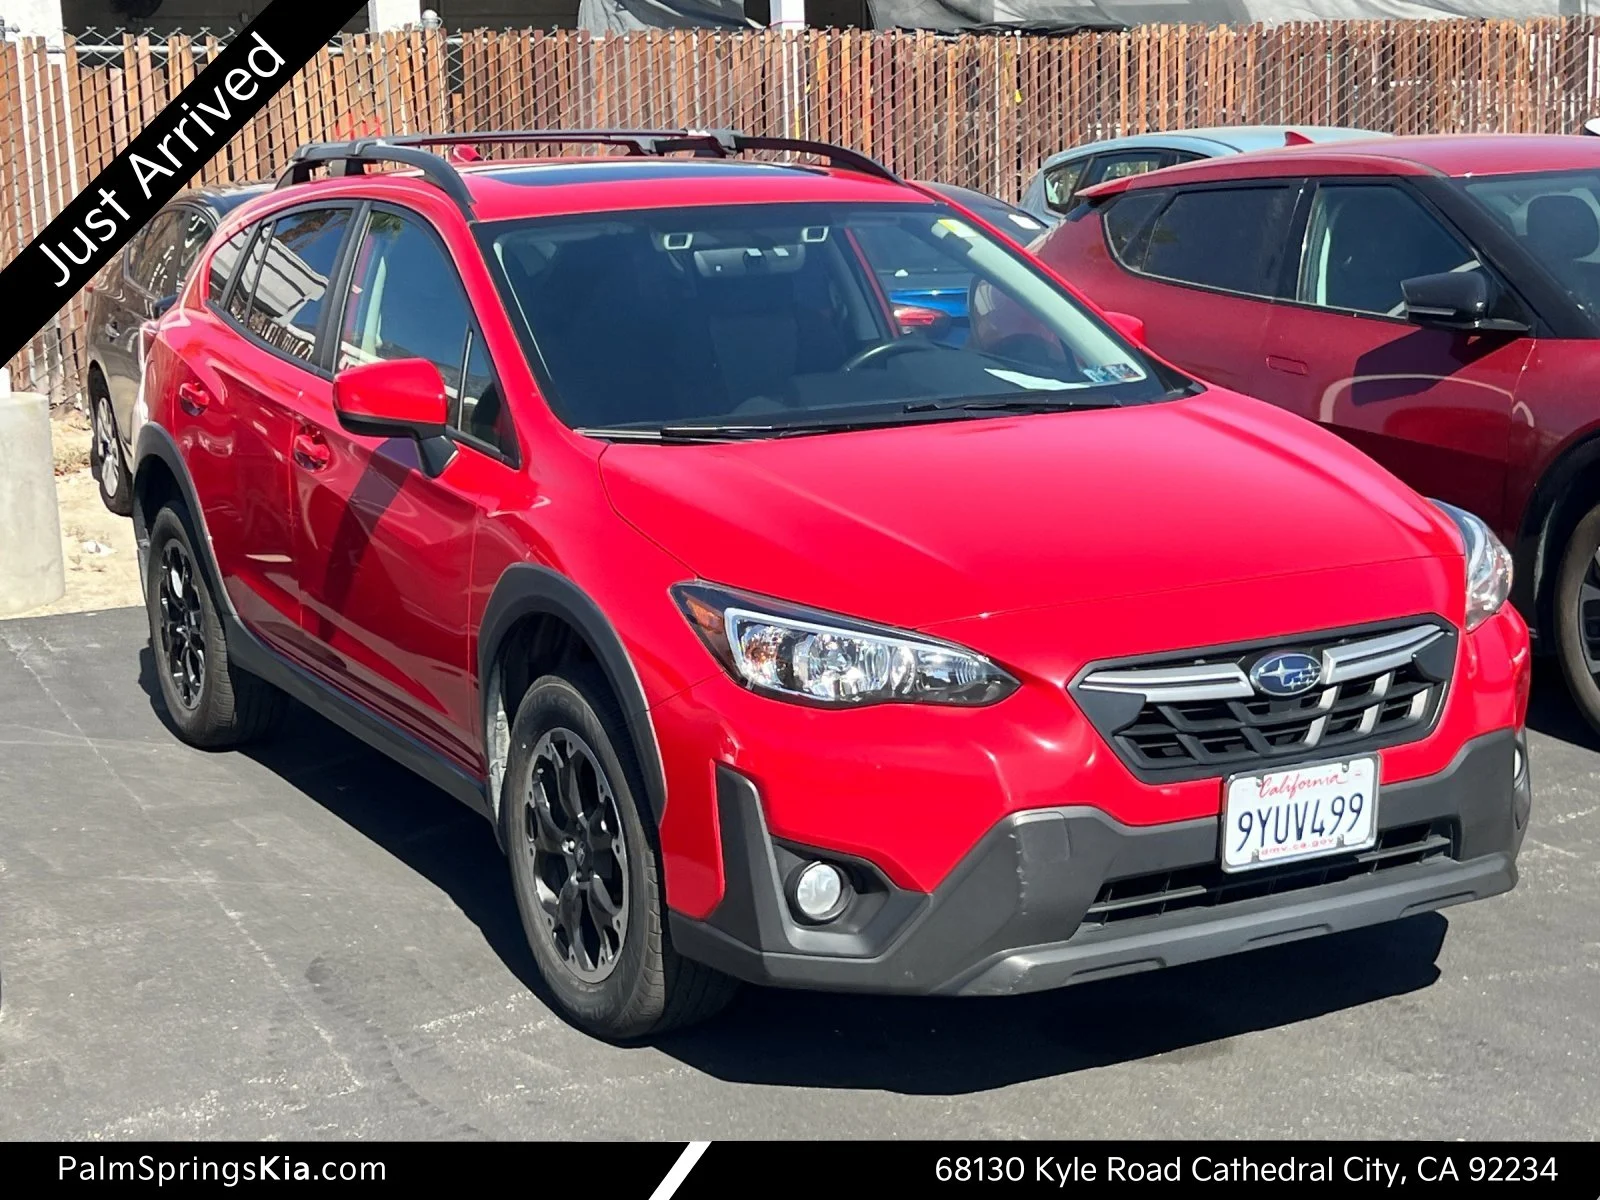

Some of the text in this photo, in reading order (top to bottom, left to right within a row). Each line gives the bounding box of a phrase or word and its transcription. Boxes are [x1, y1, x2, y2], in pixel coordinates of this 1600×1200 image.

[1259, 771, 1347, 799] California
[1236, 792, 1363, 852] 9YUV499
[1261, 838, 1334, 855] dmv.ca.gov
